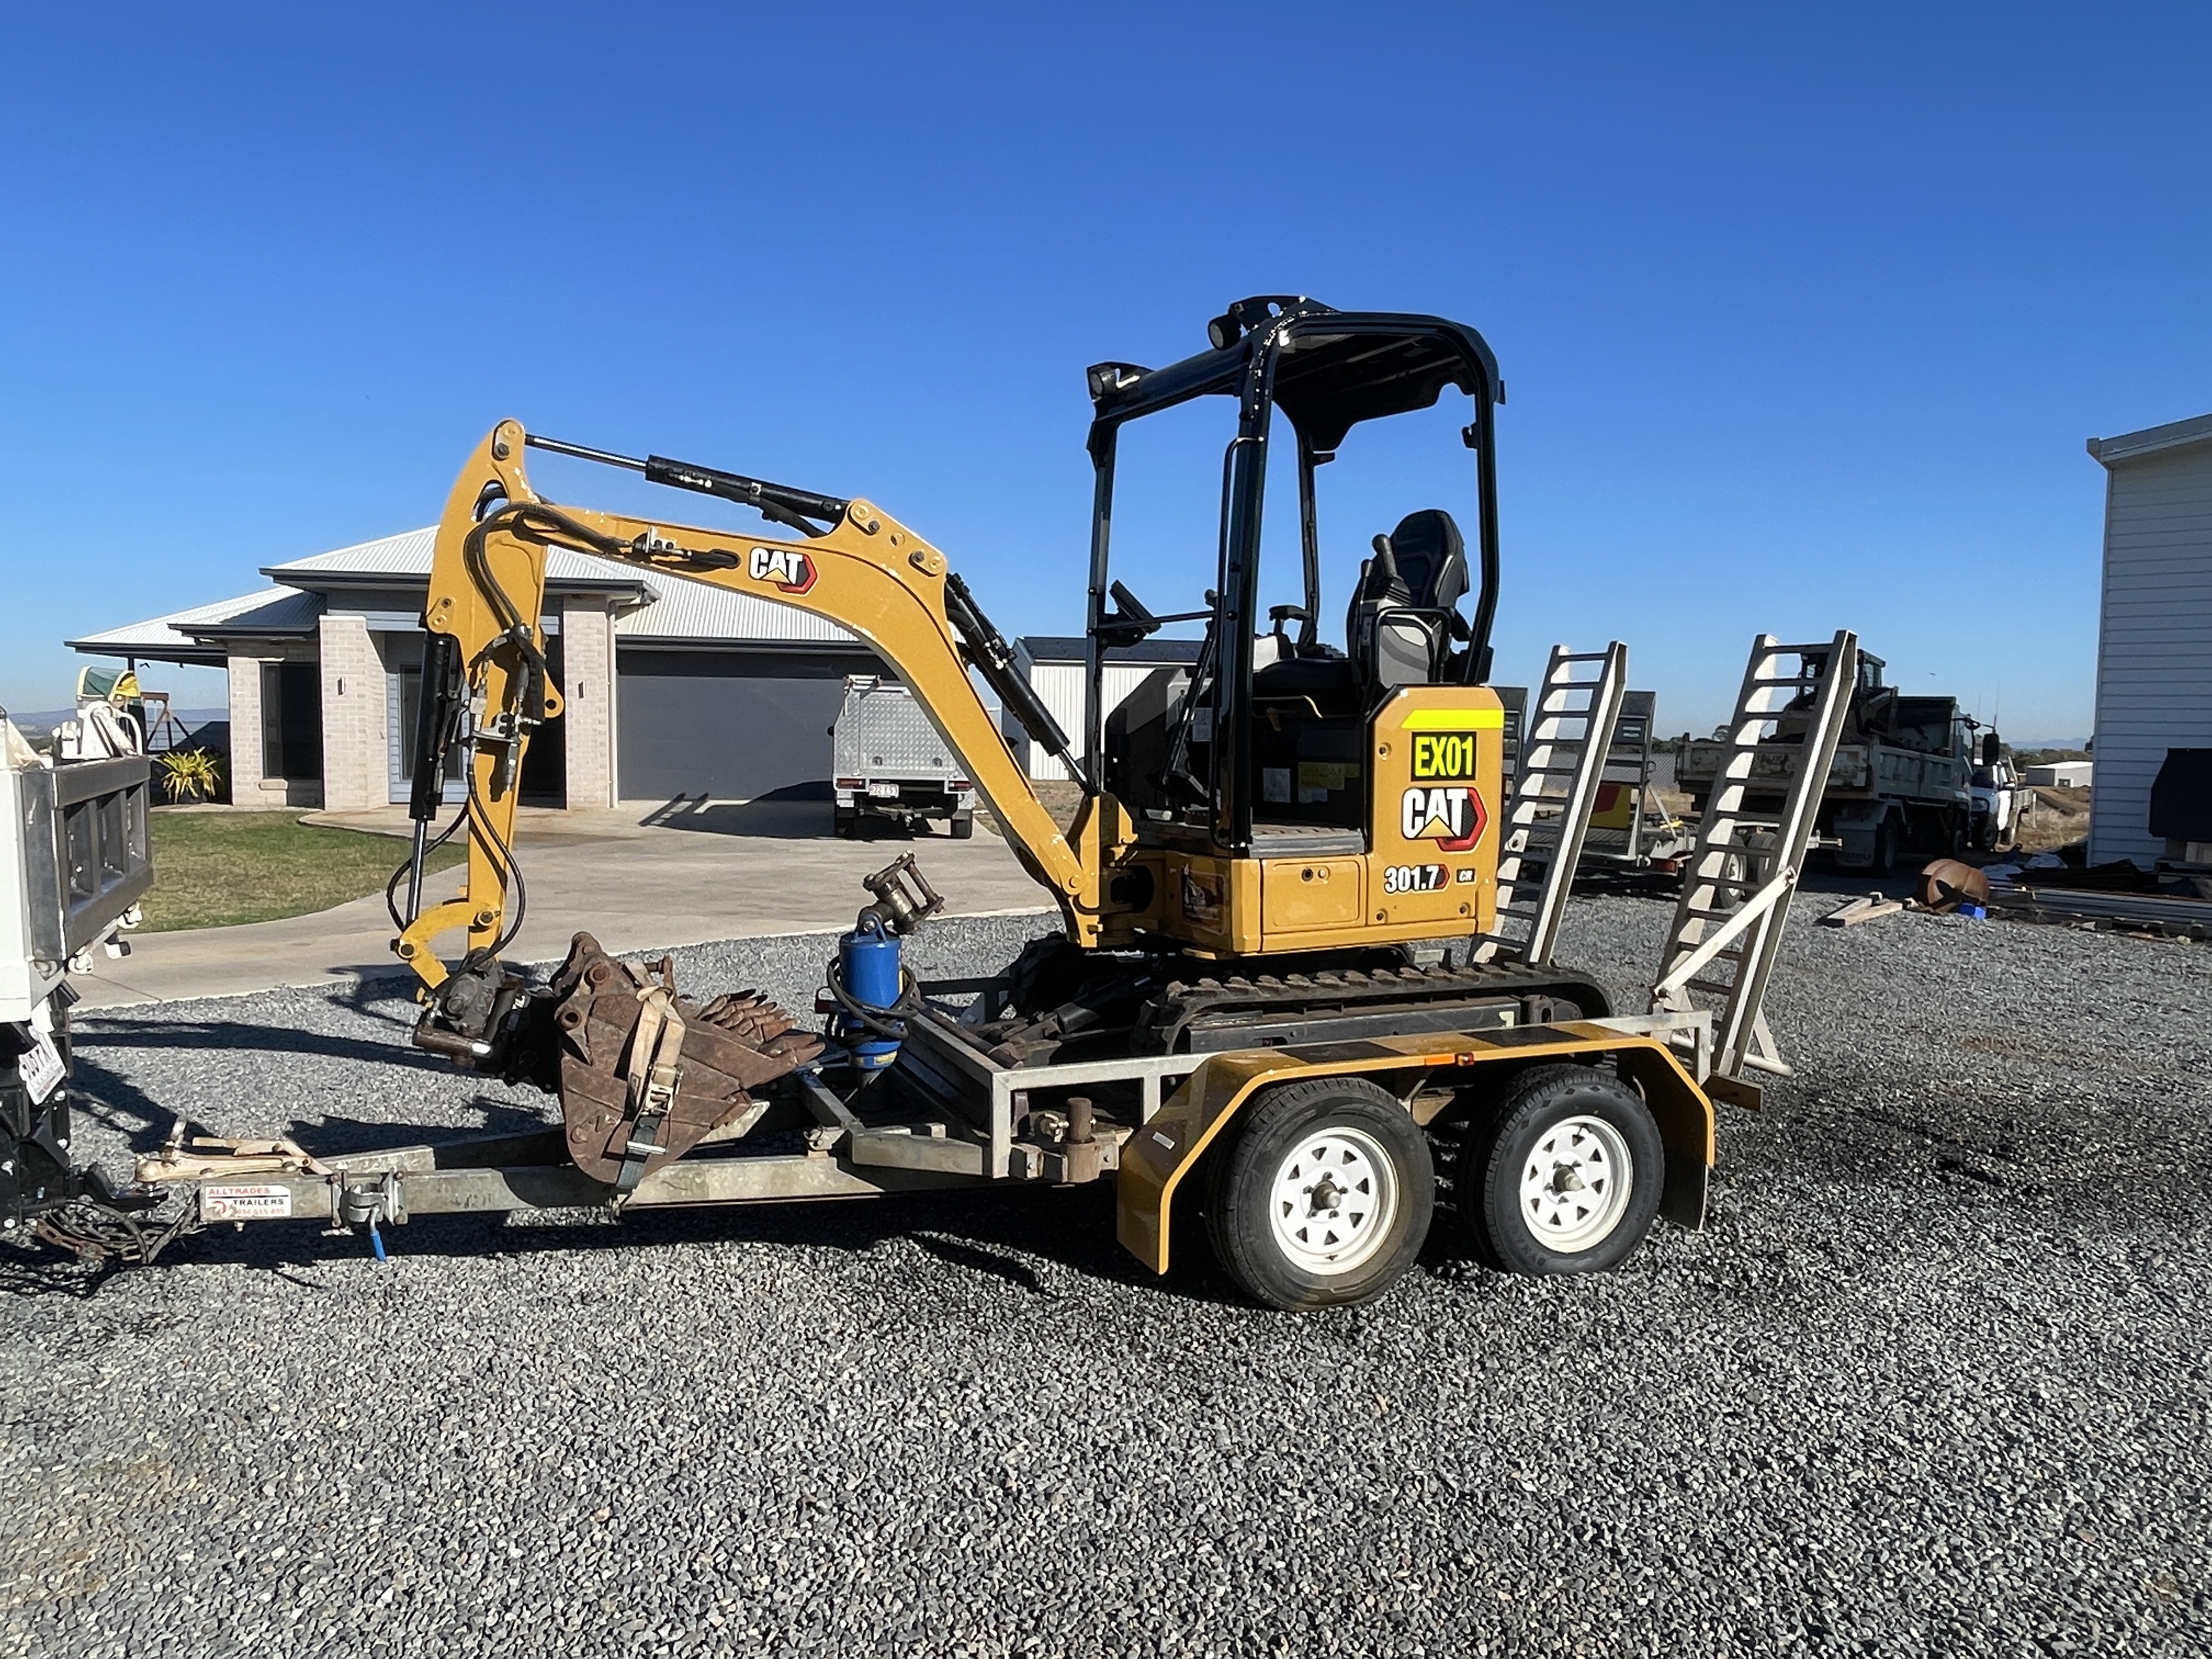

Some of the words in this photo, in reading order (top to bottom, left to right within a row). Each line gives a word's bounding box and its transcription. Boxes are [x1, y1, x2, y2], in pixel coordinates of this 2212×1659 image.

[749, 548, 803, 584] CAT
[1415, 736, 1474, 777] EX01
[1403, 788, 1468, 838] CAT
[1384, 865, 1440, 893] 301.7
